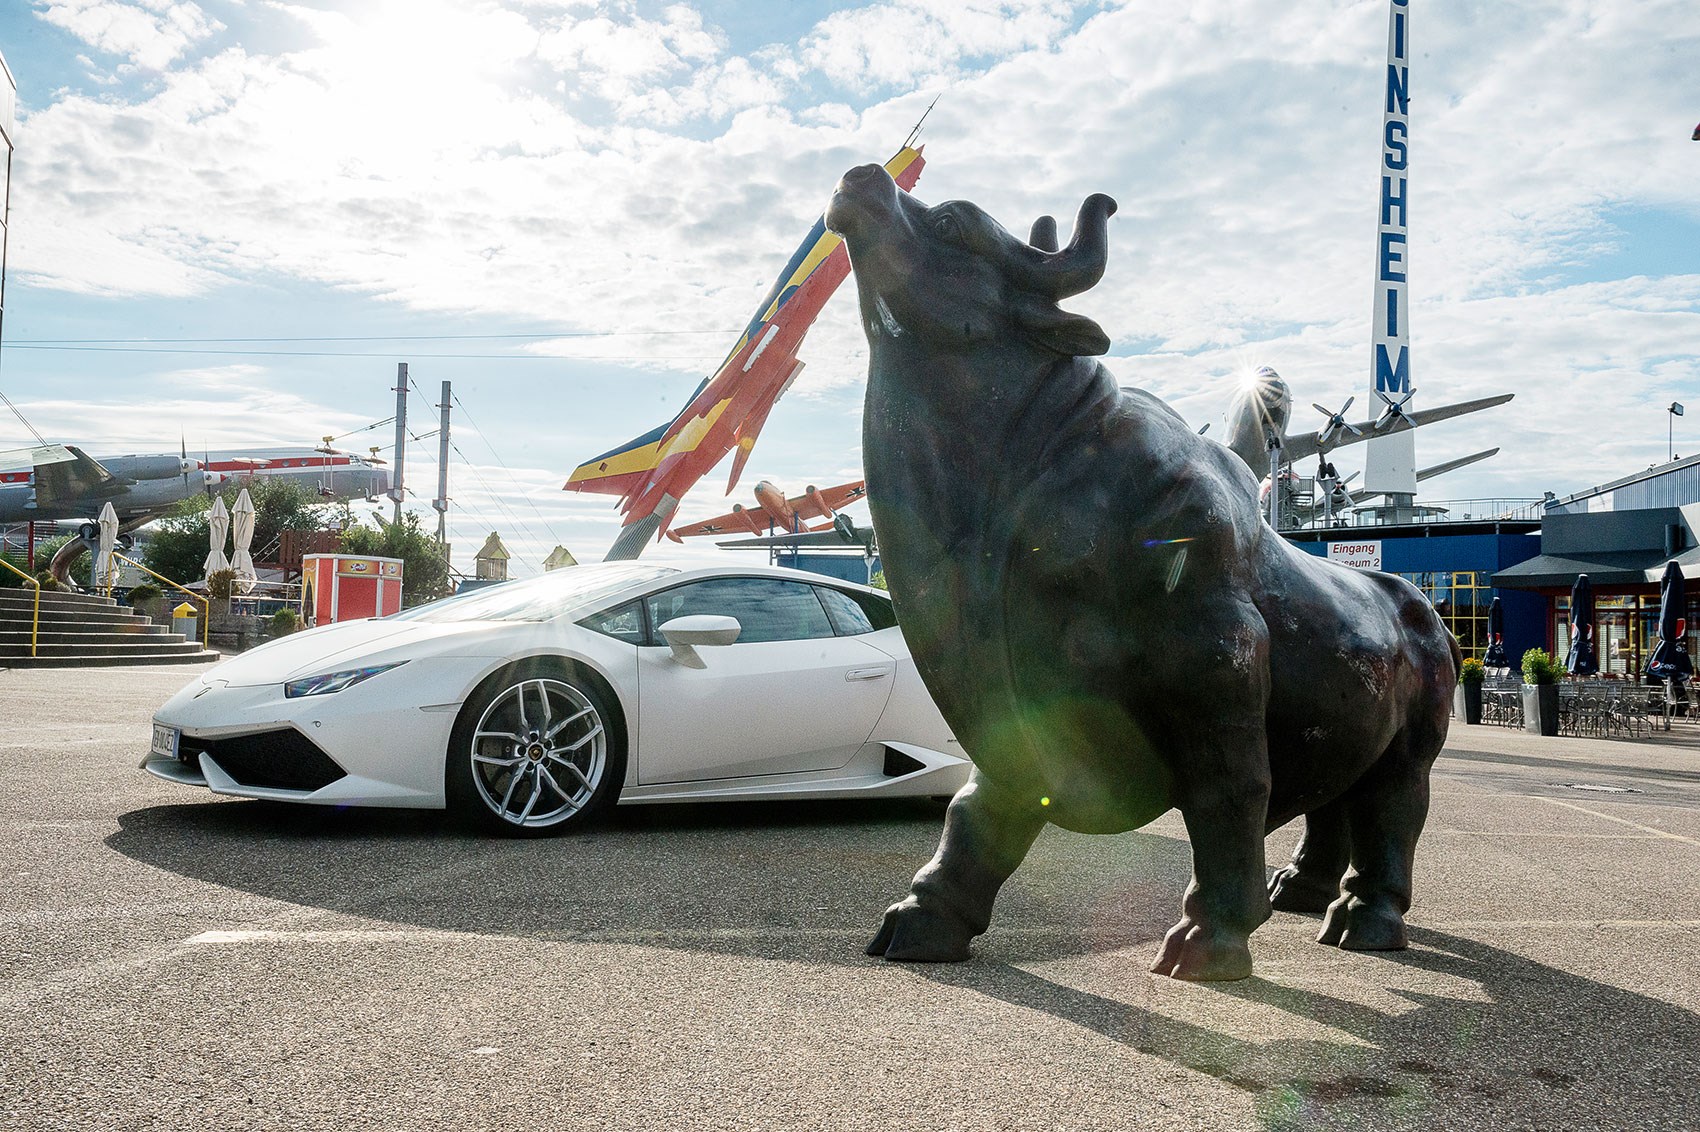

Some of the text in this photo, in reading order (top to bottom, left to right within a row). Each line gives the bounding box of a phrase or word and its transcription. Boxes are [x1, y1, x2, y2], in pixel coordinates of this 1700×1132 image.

[1376, 0, 1409, 393] INSHEIM
[1333, 544, 1375, 555] Eingang
[1373, 558, 1380, 567] 2
